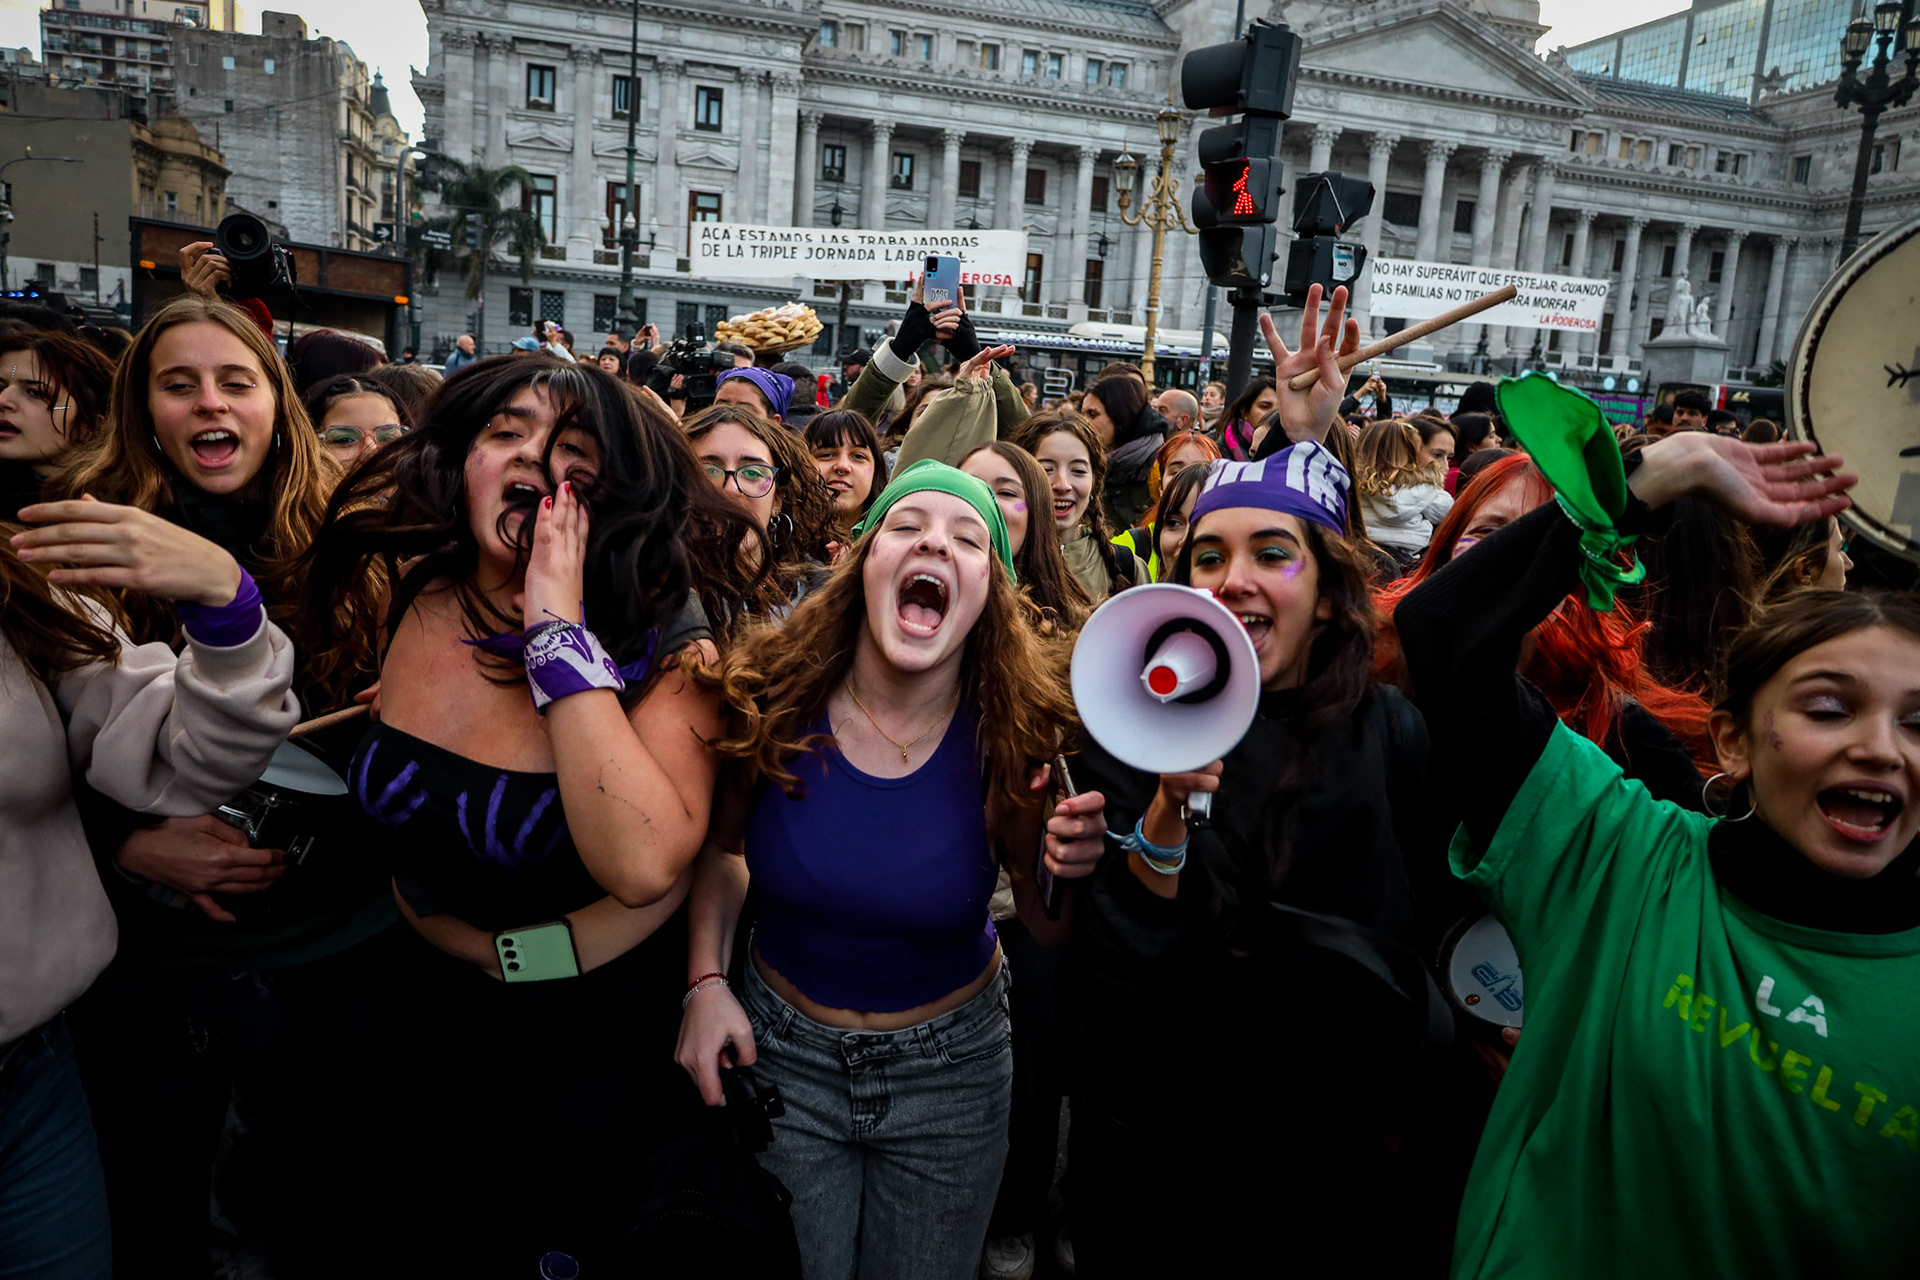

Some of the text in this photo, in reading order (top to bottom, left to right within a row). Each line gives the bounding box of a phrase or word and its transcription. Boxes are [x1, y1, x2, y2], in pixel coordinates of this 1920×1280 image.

[739, 229, 812, 243] ESTAMOS
[821, 234, 850, 244] LAS
[702, 243, 976, 263] DE LA TRIPLE JORNADA LABOL.
[1374, 262, 1390, 275] NO
[1393, 264, 1414, 277] HAY
[1416, 265, 1476, 283] SUPERÁVIT
[1479, 272, 1501, 286] QUE
[1561, 281, 1607, 297] CUANDO
[1372, 281, 1393, 295] LAS
[1396, 283, 1444, 299] FAMILIAS
[1446, 288, 1462, 300] NO
[1532, 296, 1577, 311] MORFAR
[1540, 314, 1597, 329] LA PODEROSA
[1755, 975, 1829, 1038] LA
[1662, 973, 1920, 1150] REVUELTA
